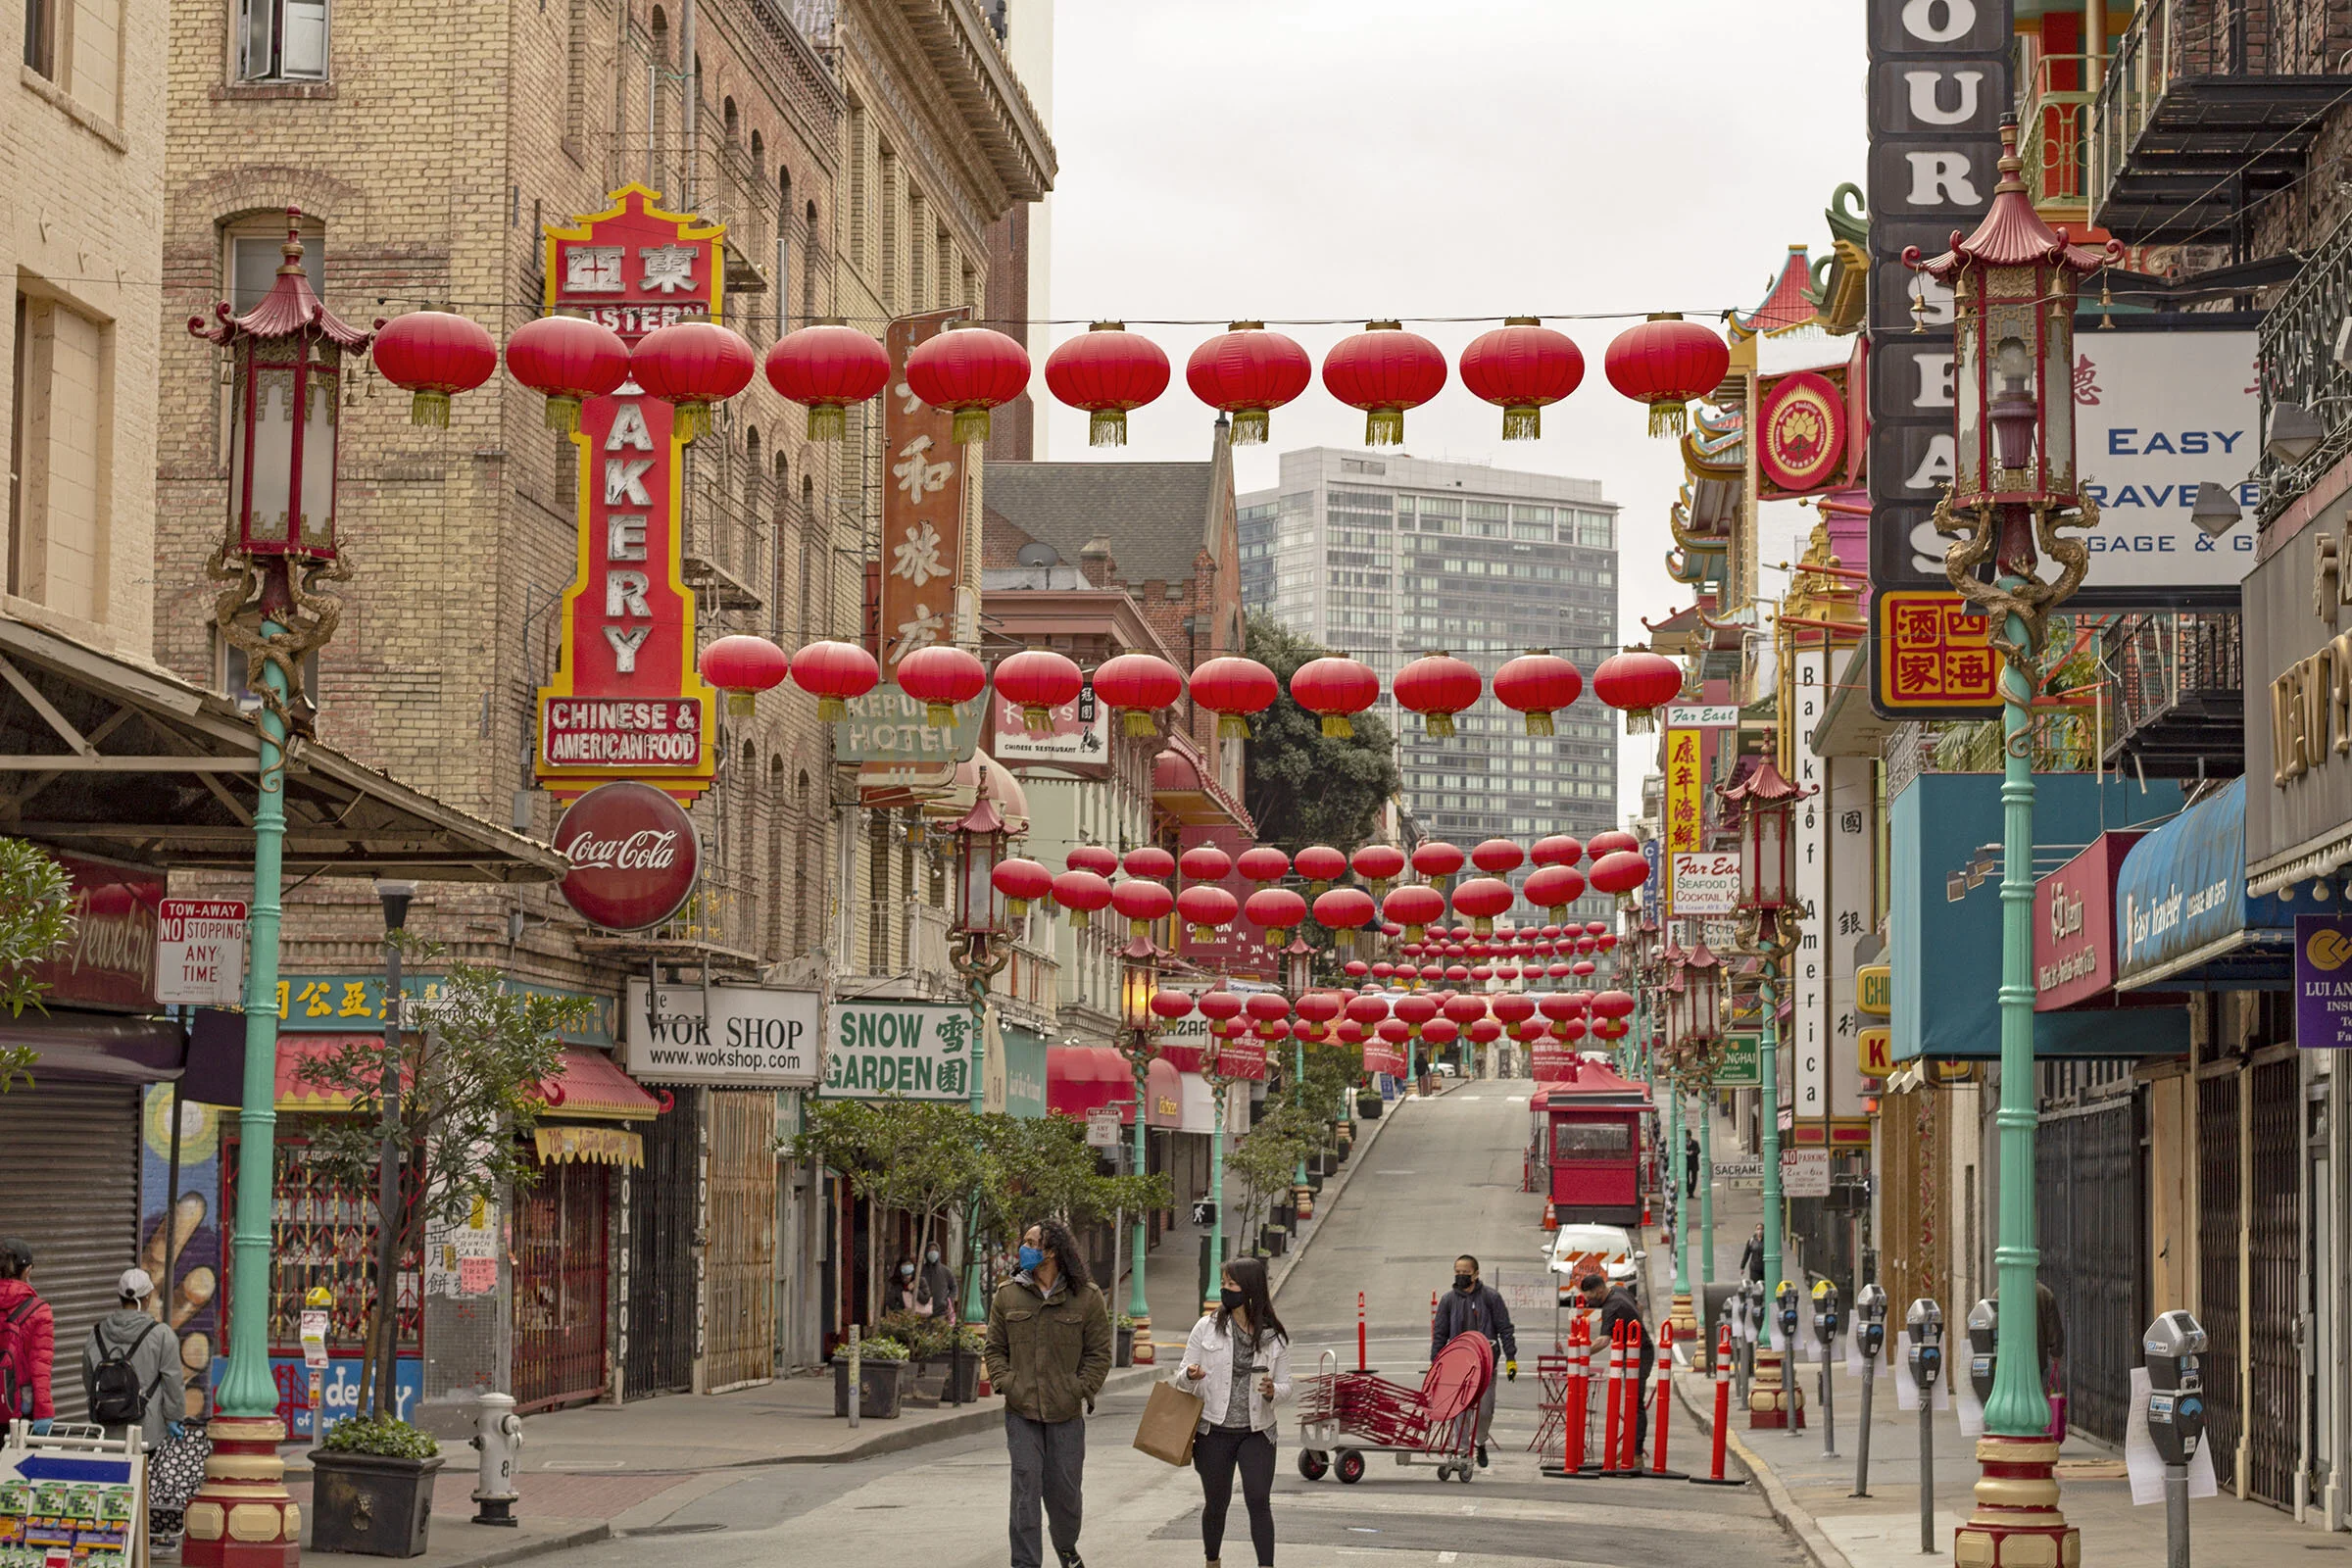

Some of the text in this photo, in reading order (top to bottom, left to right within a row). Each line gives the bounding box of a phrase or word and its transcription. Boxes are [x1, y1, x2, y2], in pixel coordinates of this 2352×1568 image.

[588, 305, 705, 332] ASTERN
[2109, 428, 2244, 456] EASY
[602, 377, 657, 673] AKERY
[2195, 532, 2216, 552] &
[552, 703, 696, 730] CHINESE &
[1672, 708, 1734, 723] Far East
[1803, 667, 1814, 780] Bank
[553, 734, 696, 760] AMERICAN FOOD
[850, 724, 962, 752] HOTEL
[1035, 745, 1077, 754] RESTAURANT
[1677, 856, 1707, 877] Far
[1677, 877, 1728, 890] SEAFOOD
[169, 903, 238, 917] TOW-AWAY
[2152, 883, 2183, 937] Traveler
[160, 918, 242, 941] NO STOPPING
[185, 946, 218, 961] ANY
[182, 965, 219, 983] TIME
[1801, 899, 1818, 1102] America
[2305, 982, 2331, 997] LUI
[646, 1012, 804, 1051] WOK SHOP
[840, 1011, 923, 1048] SNOW
[650, 1049, 801, 1072] www.wokshop.com
[827, 1054, 933, 1091] GARDEN
[1784, 1151, 1827, 1164] NO PARKING
[1715, 1164, 1764, 1176] SACRAME
[457, 1248, 488, 1256] CAKE
[618, 1248, 630, 1360] SHOP
[697, 1257, 706, 1353] SHOP
